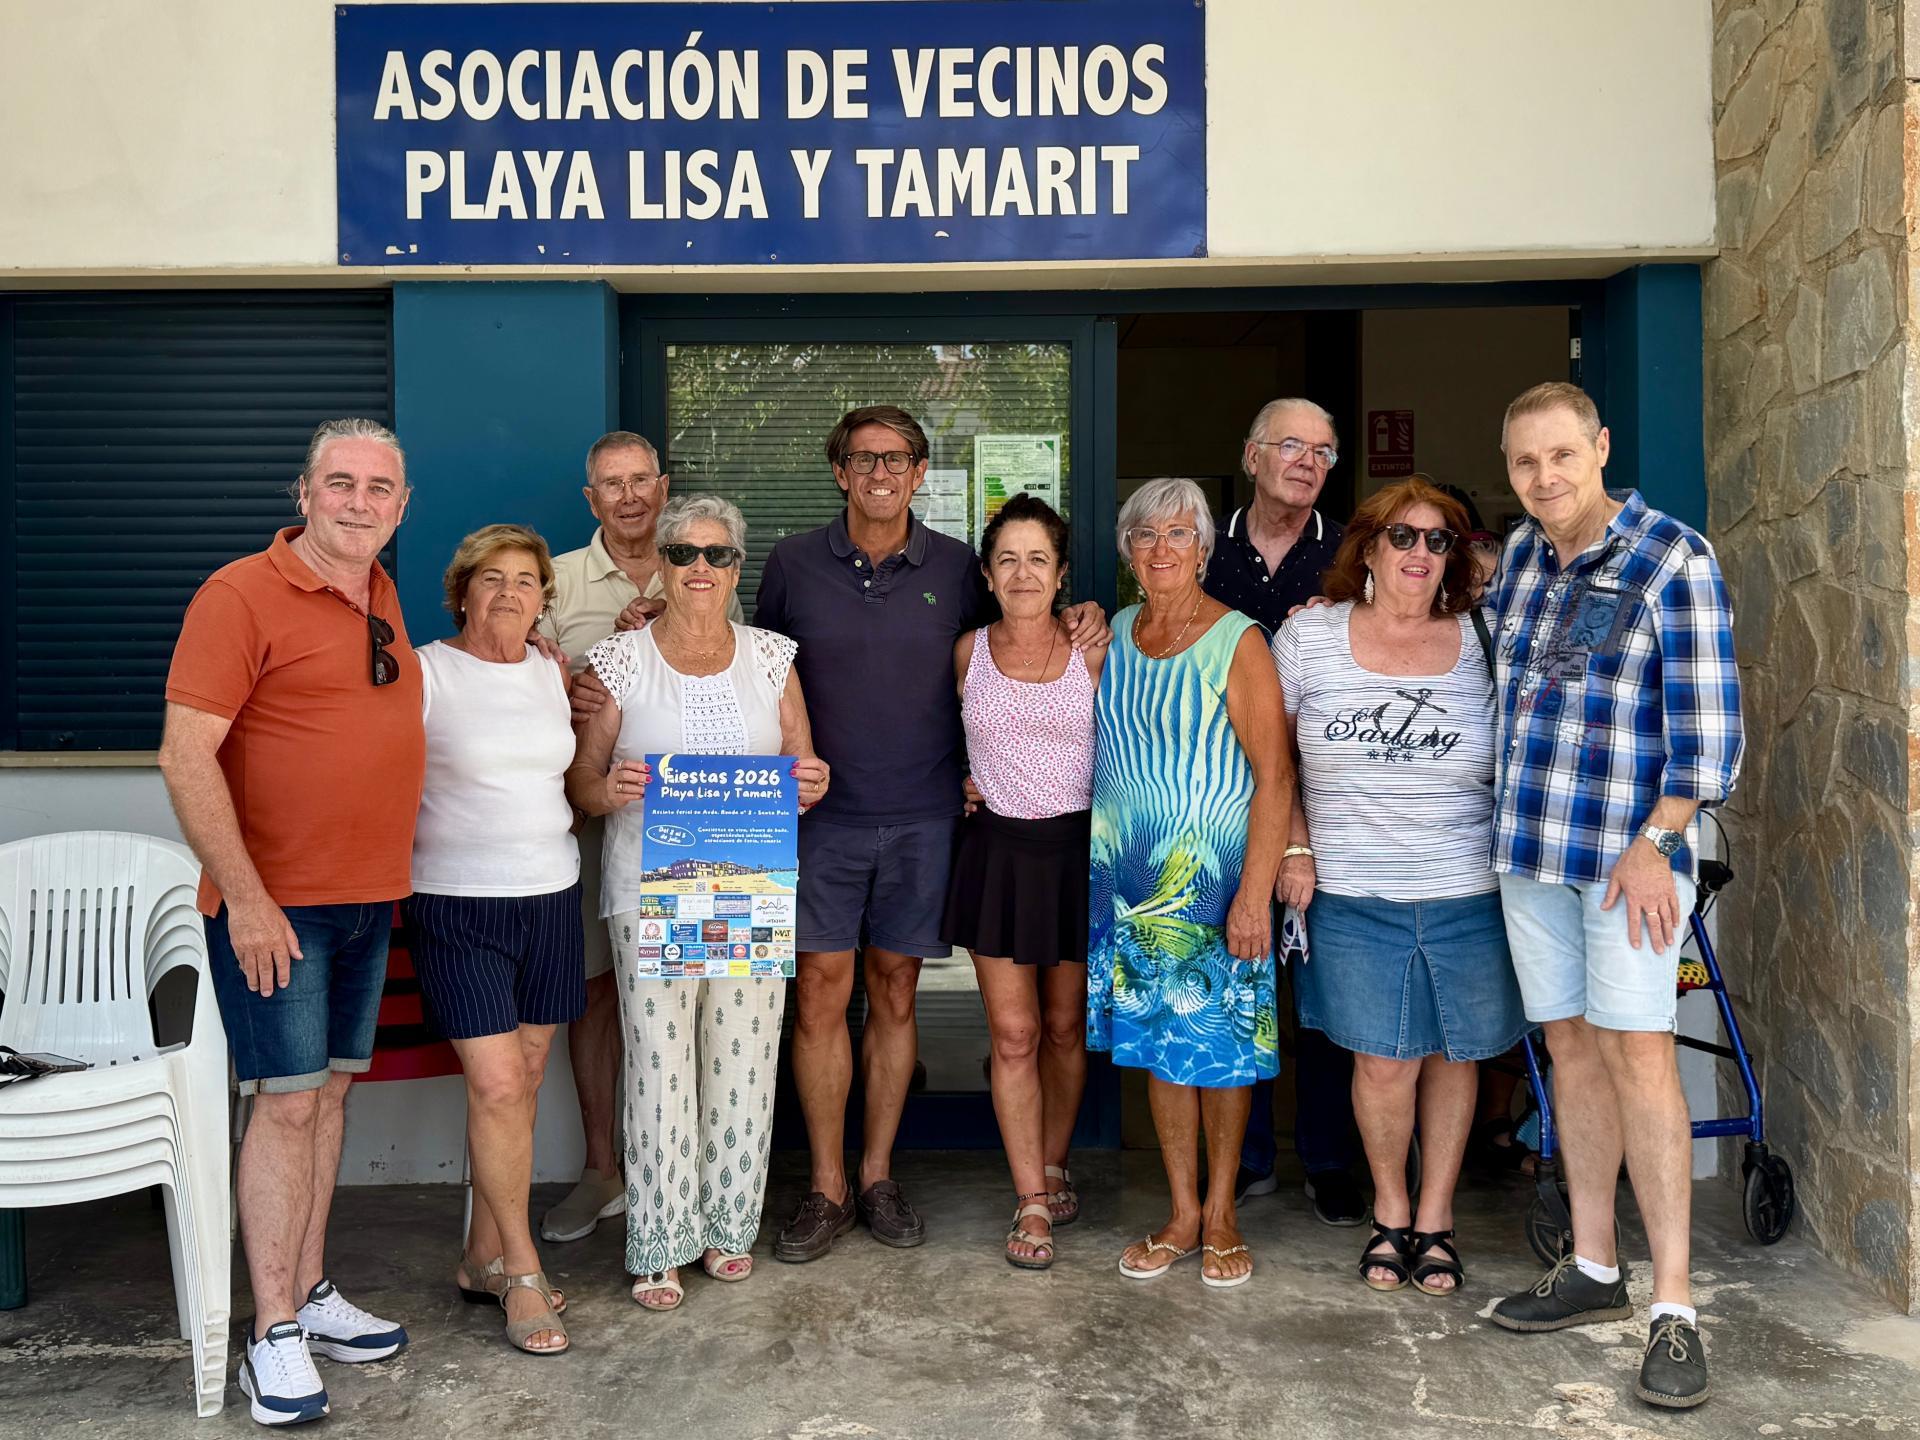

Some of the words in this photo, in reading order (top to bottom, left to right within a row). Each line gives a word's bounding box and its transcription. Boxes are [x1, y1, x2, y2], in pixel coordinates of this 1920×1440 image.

[373, 30, 759, 121] ASOCIACIÓN
[787, 49, 869, 119] DE
[891, 43, 1168, 118] VECINOS
[405, 150, 605, 220] PLAYA
[629, 149, 769, 220] LISA
[790, 149, 833, 219] Y
[855, 145, 1140, 218] TAMARIT
[1371, 463, 1411, 471] EXTINTOR
[1324, 708, 1462, 760] Sailing
[661, 786, 694, 802] Playa
[697, 787, 720, 800] Lisa
[723, 790, 730, 802] y
[735, 788, 783, 799] Tamarit
[663, 767, 728, 785] Fiestas
[733, 769, 780, 786] 2026
